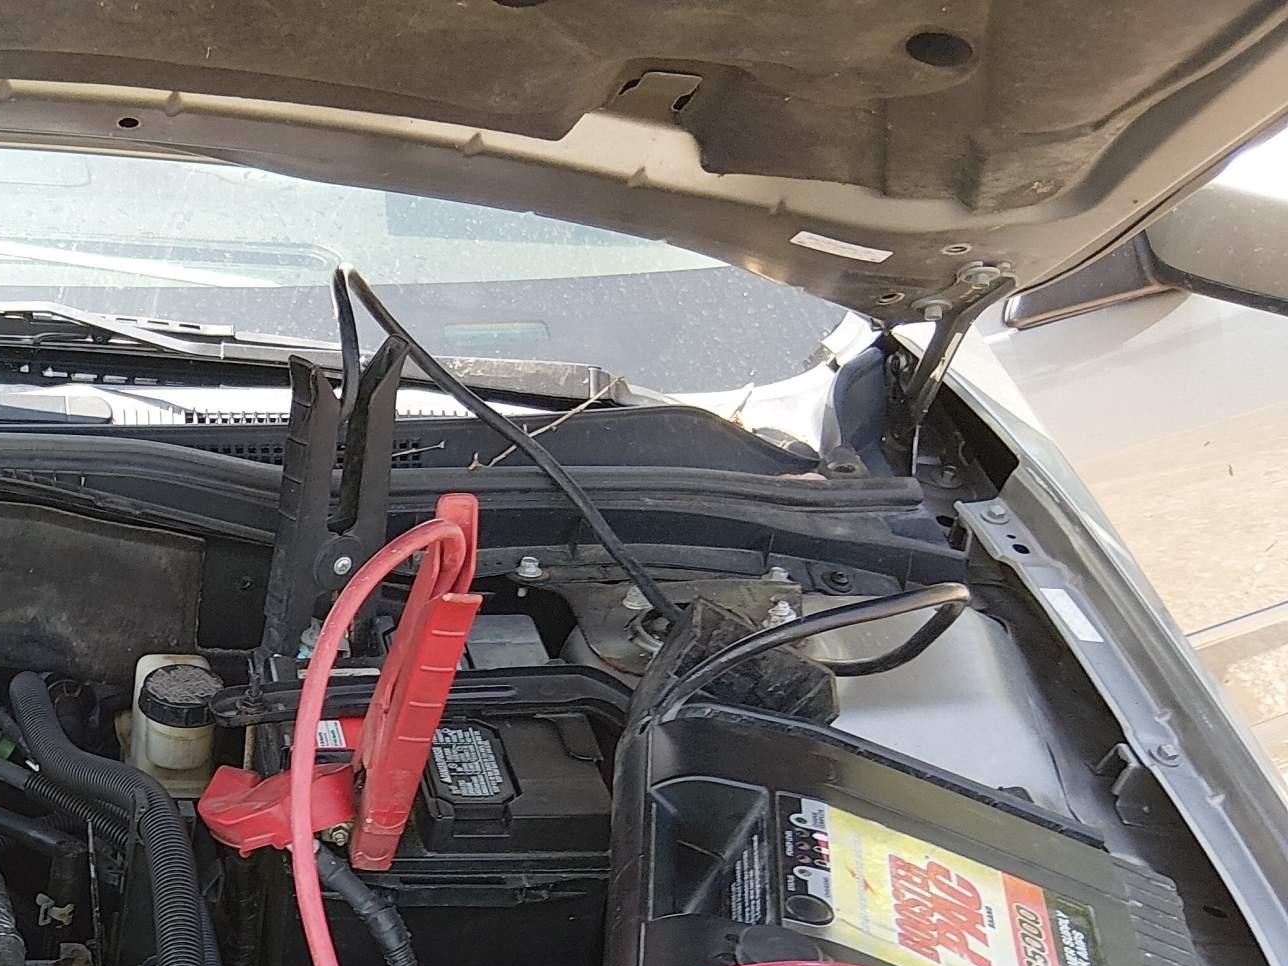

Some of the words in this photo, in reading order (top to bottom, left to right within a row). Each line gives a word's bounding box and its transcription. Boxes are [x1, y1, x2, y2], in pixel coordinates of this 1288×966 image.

[888, 853, 942, 965] BOOSTER
[1055, 909, 1074, 948] SUPPLY
[1071, 929, 1090, 961] AMPS
